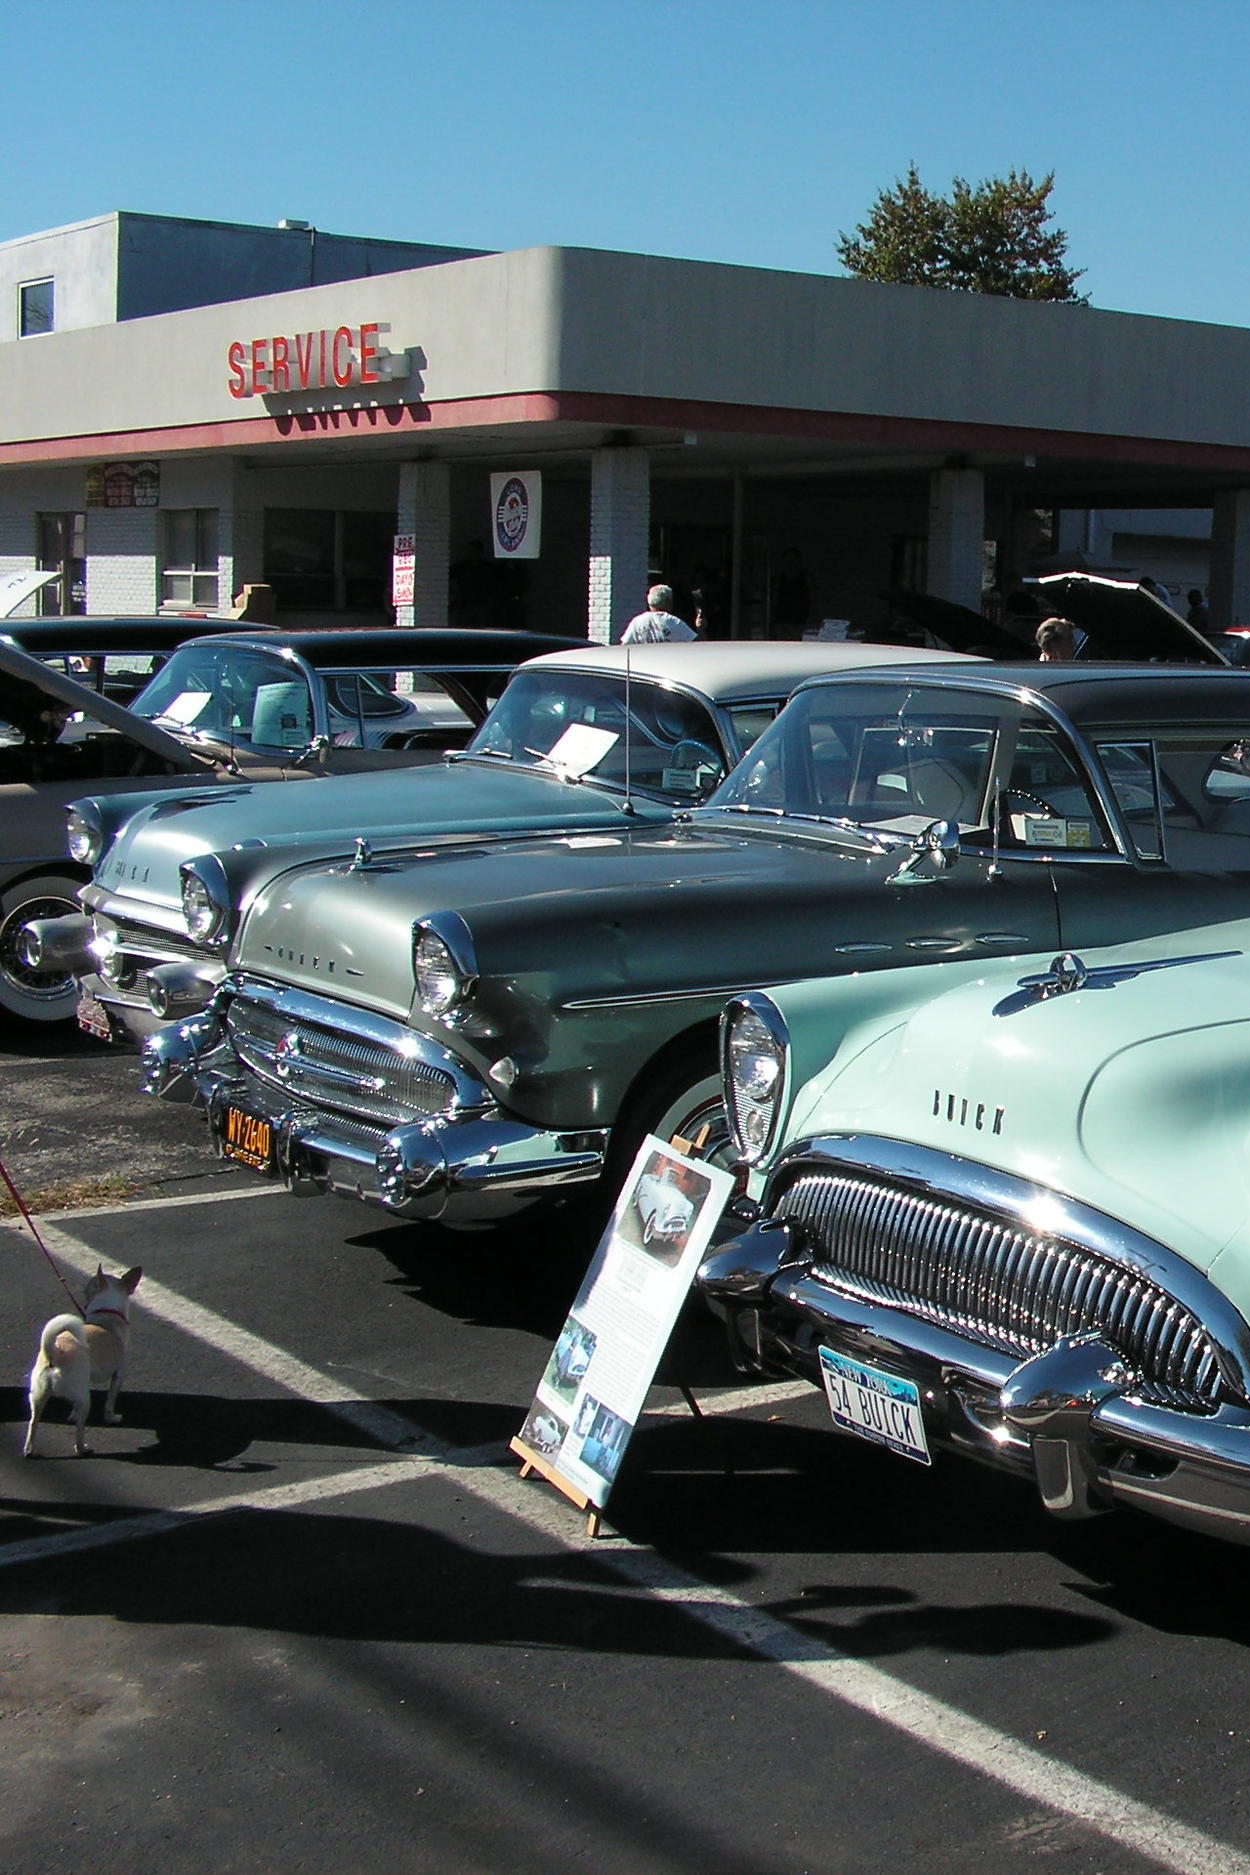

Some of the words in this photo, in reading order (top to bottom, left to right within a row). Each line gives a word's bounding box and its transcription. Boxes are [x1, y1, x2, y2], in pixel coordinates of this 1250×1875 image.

[228, 323, 379, 399] SERVICE
[932, 1089, 1005, 1136] BUICK
[829, 1373, 853, 1417] 54
[858, 1387, 918, 1446] BUICK
